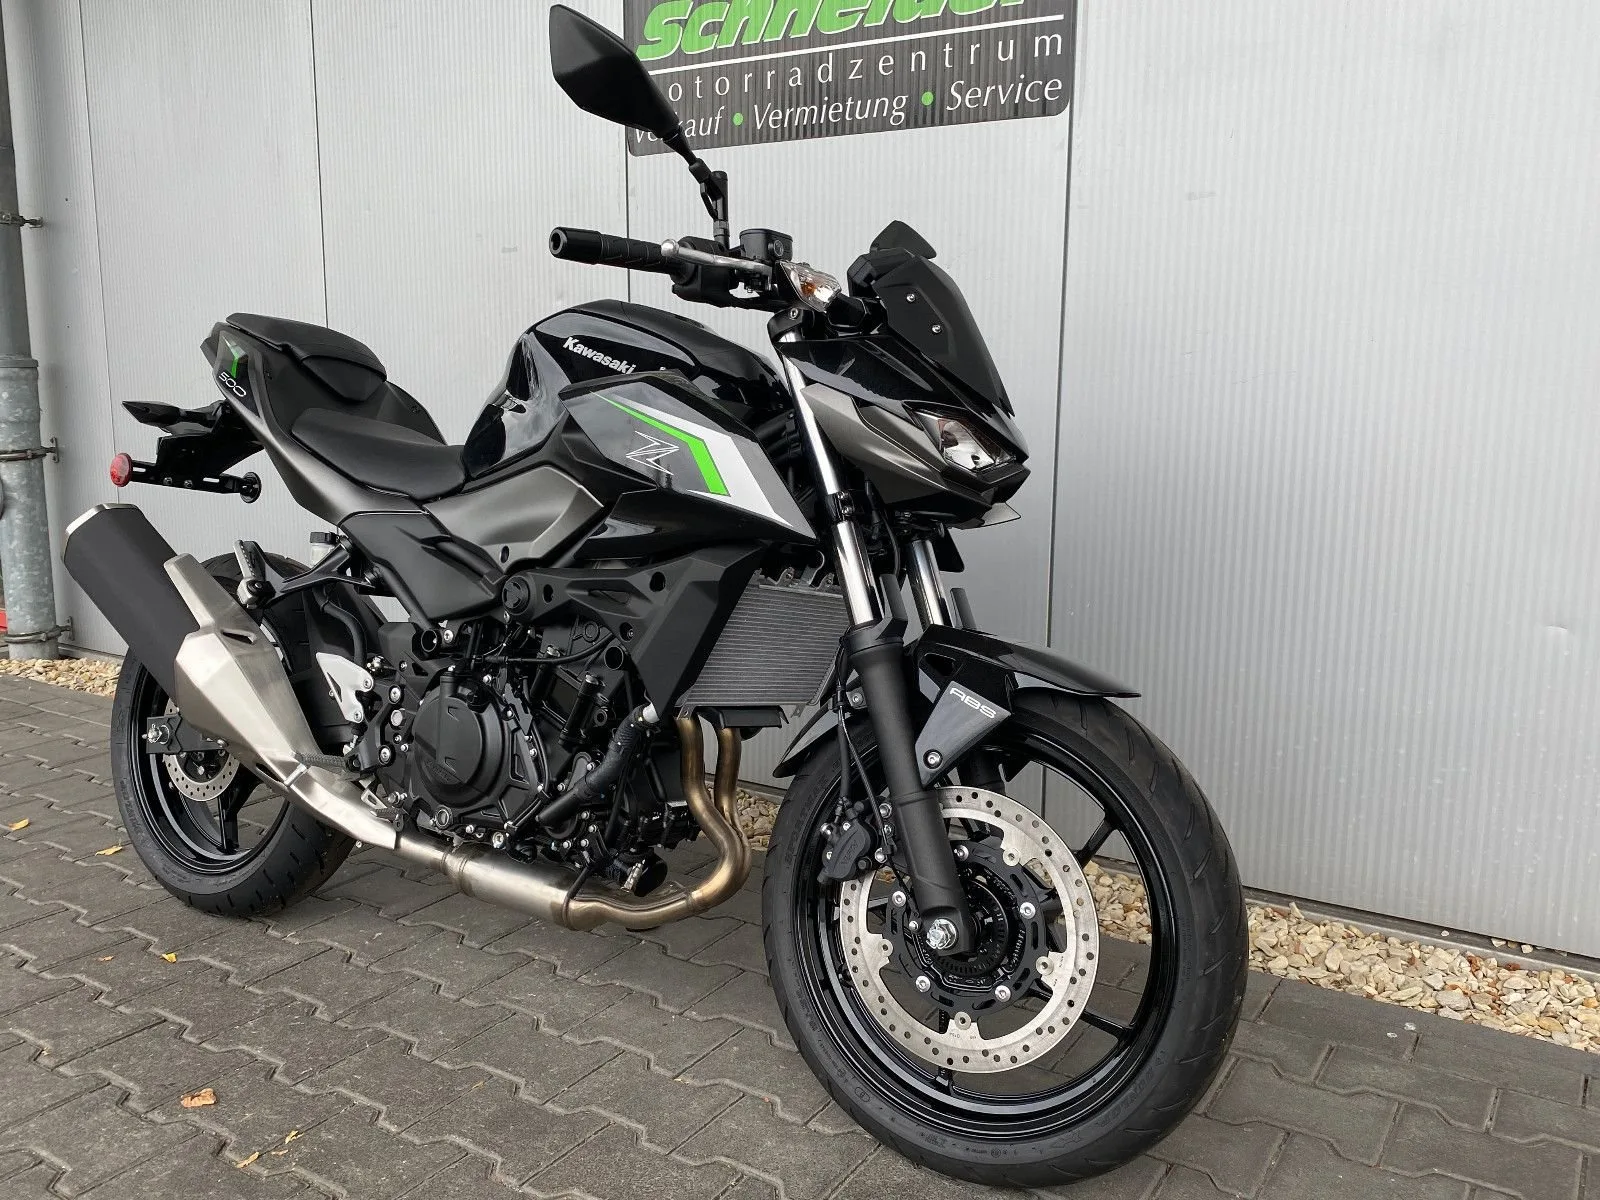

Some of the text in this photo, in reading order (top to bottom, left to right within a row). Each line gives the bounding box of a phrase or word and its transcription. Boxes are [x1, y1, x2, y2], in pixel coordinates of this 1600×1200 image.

[636, 0, 1025, 61] Schne
[668, 33, 1062, 101] otorradzentrum
[753, 94, 908, 129] Vermietung
[946, 75, 1062, 111] Service
[563, 337, 636, 374] Kawasaki
[218, 371, 247, 397] 500
[950, 687, 996, 719] ABS
